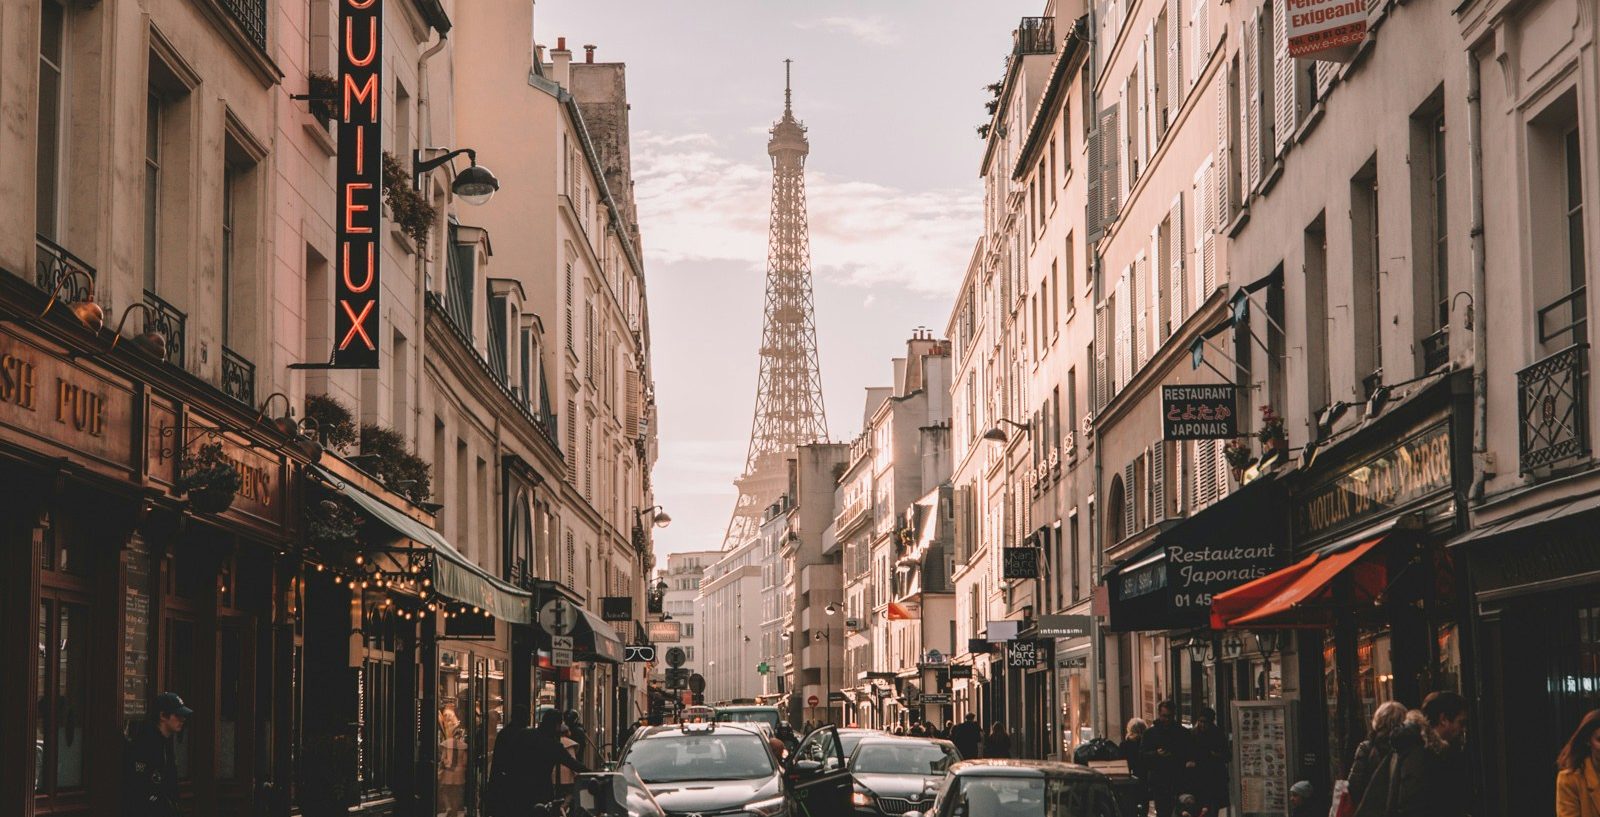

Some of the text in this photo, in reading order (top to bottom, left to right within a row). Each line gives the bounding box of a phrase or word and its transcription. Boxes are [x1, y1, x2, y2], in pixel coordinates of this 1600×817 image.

[339, 0, 377, 351] UMIEUX
[1165, 388, 1231, 400] RESTAURANT
[1167, 404, 1231, 421] とよたか
[1171, 423, 1228, 436] JAPONAIS
[1309, 487, 1349, 530] MOULIN
[1010, 550, 1034, 560] Karl
[1168, 543, 1275, 563] Restaurant
[1005, 558, 1035, 569] Marc
[1006, 567, 1035, 577] John
[1180, 565, 1266, 587] Japonais
[1175, 593, 1212, 607] 01 45
[1013, 641, 1035, 652] Karl
[1009, 649, 1035, 659] Marc
[1009, 658, 1035, 666] John
